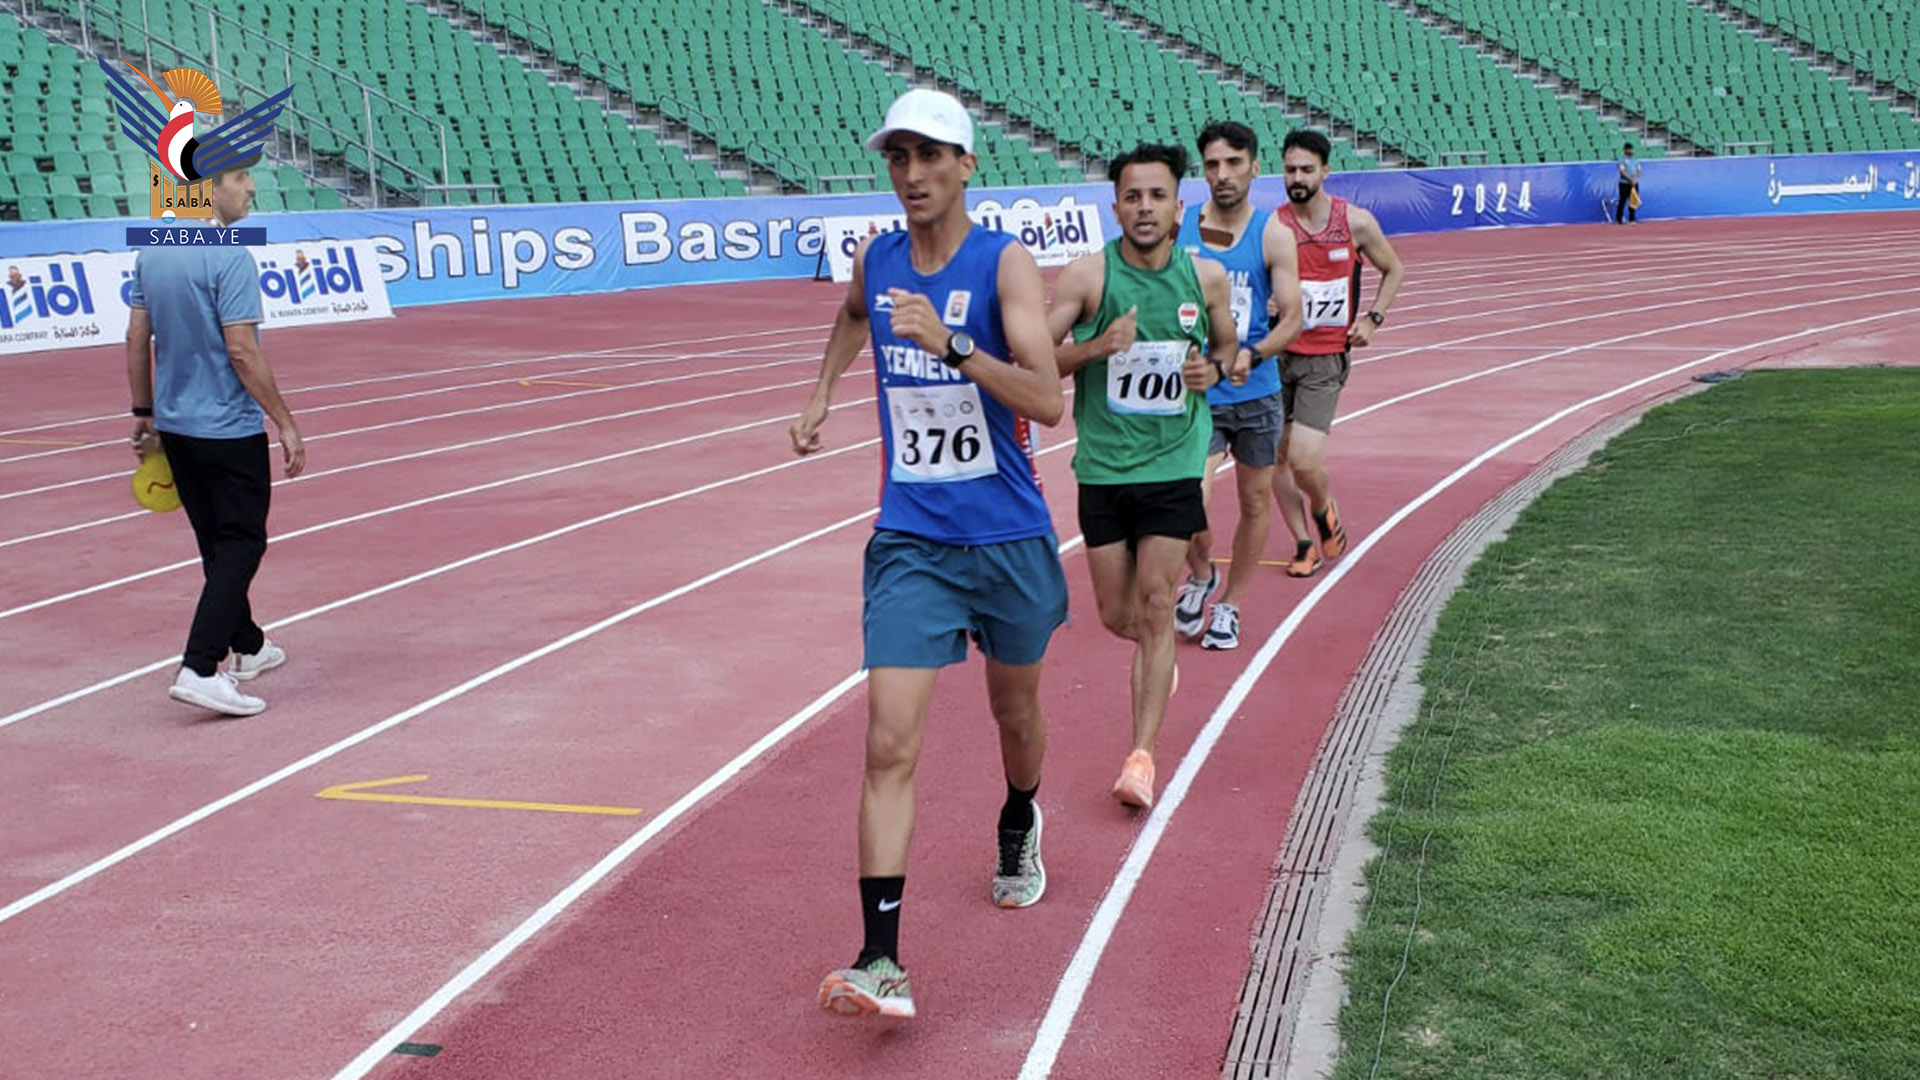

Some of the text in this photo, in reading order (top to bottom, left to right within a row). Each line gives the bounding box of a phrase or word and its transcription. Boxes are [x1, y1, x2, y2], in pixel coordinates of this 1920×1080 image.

[1451, 181, 1532, 216] 2024
[620, 211, 824, 266] Basra
[1306, 299, 1345, 318] 177
[881, 345, 961, 381] YEMEN
[1116, 371, 1182, 401] 100
[902, 424, 981, 466] 376
